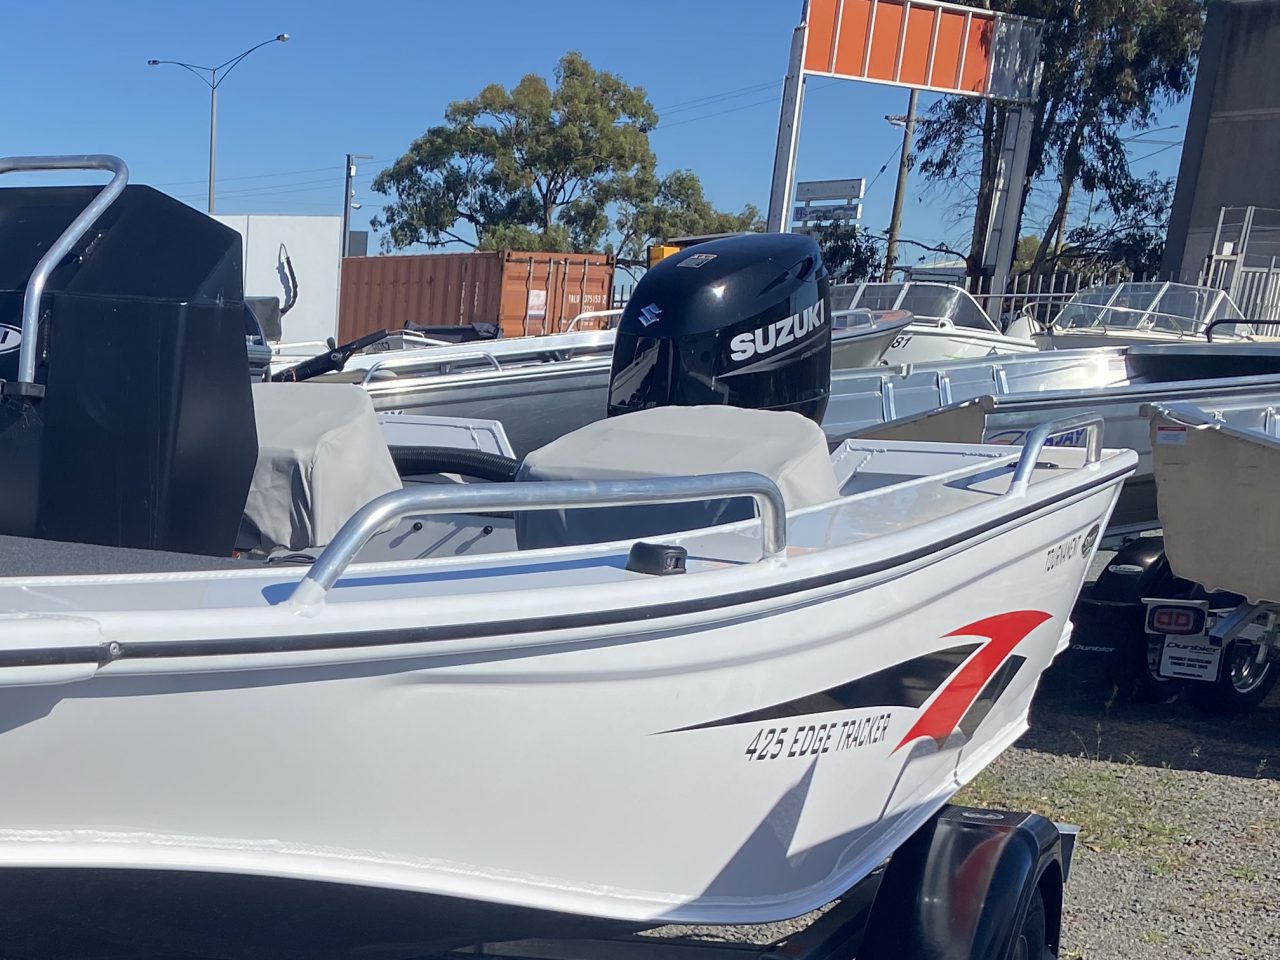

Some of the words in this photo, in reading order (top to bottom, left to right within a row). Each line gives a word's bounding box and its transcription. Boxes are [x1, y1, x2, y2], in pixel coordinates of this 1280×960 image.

[730, 298, 824, 361] SUZUKI
[891, 336, 912, 348] 81
[1044, 534, 1082, 573] TOURNAMENT
[1166, 642, 1219, 653] Dunbier
[745, 727, 788, 761] 425
[787, 722, 837, 757] EDGE
[836, 713, 891, 751] TRACKER
